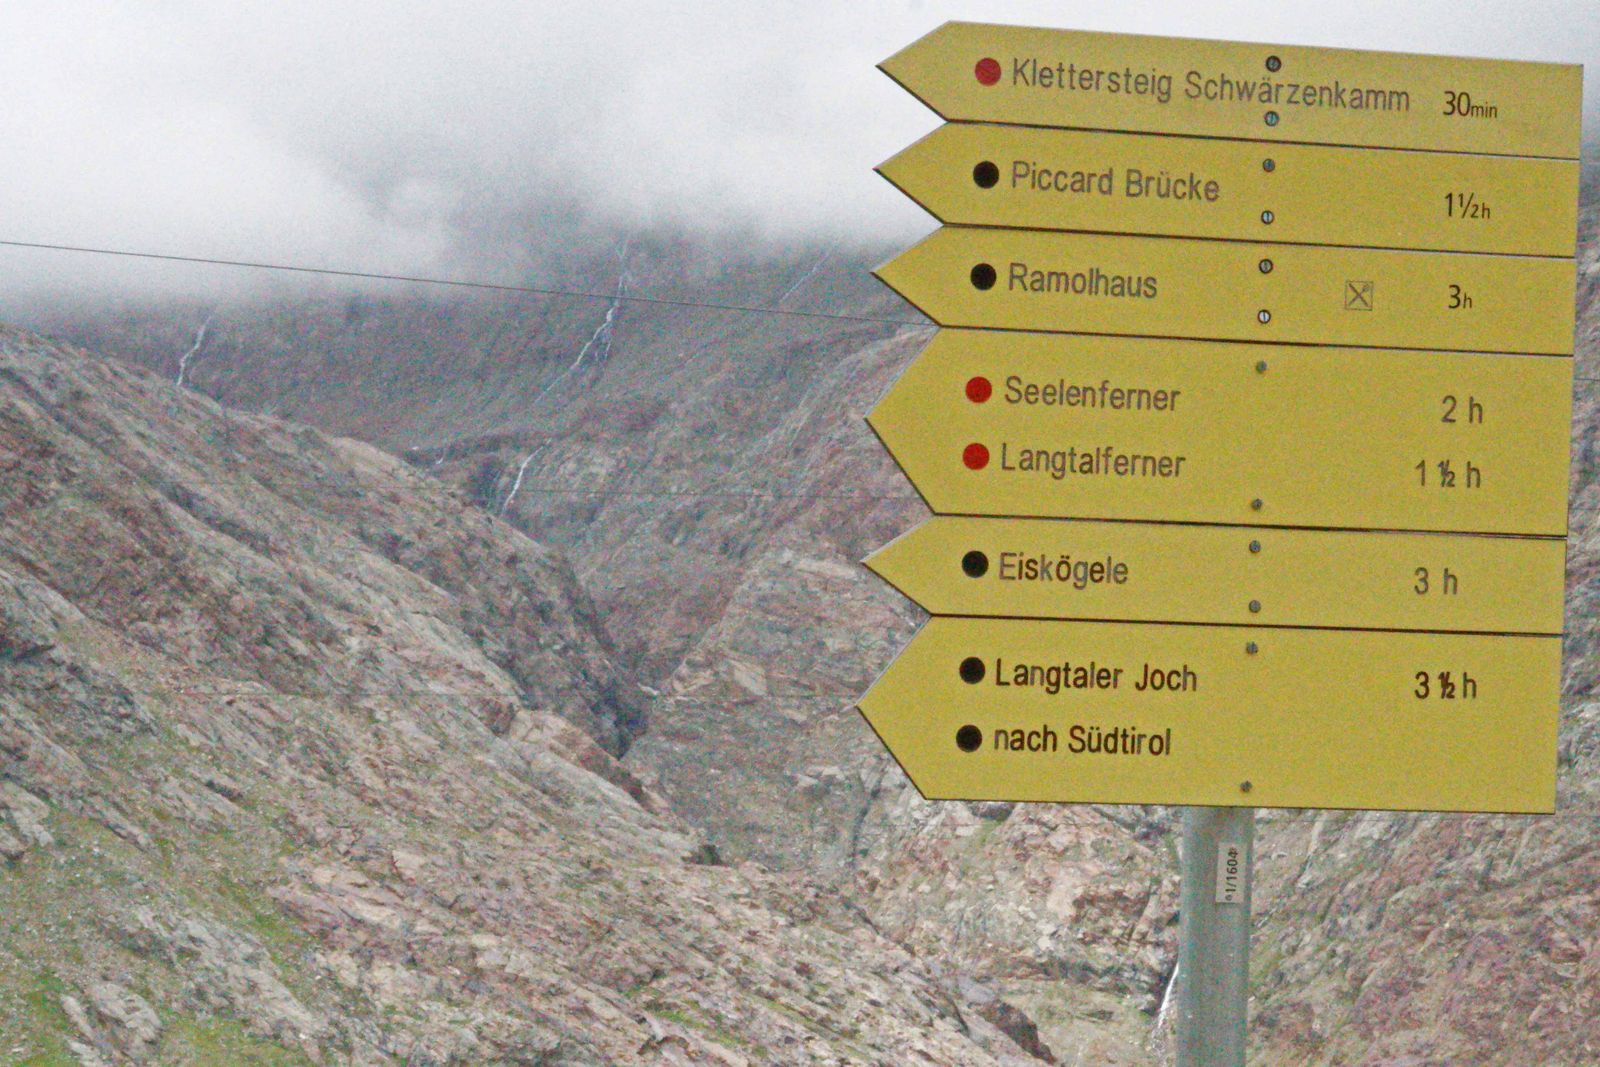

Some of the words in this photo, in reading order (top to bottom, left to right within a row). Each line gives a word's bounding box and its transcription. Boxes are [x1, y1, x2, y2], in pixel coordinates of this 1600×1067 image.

[1012, 57, 1172, 104] Klettersteig
[1184, 70, 1410, 112] Schwärzenkamm
[1011, 160, 1112, 196] Piccard
[1125, 168, 1220, 202] Brücke
[1008, 262, 1157, 299] Ramolhaus
[1004, 375, 1181, 411] Seelenferner
[1001, 442, 1186, 481] Langtalferner
[999, 552, 1130, 591] Eiskögele
[995, 657, 1124, 696] Langtaler
[1134, 663, 1198, 692] Joch
[994, 724, 1058, 753] nach
[1067, 724, 1171, 756] Südtirol
